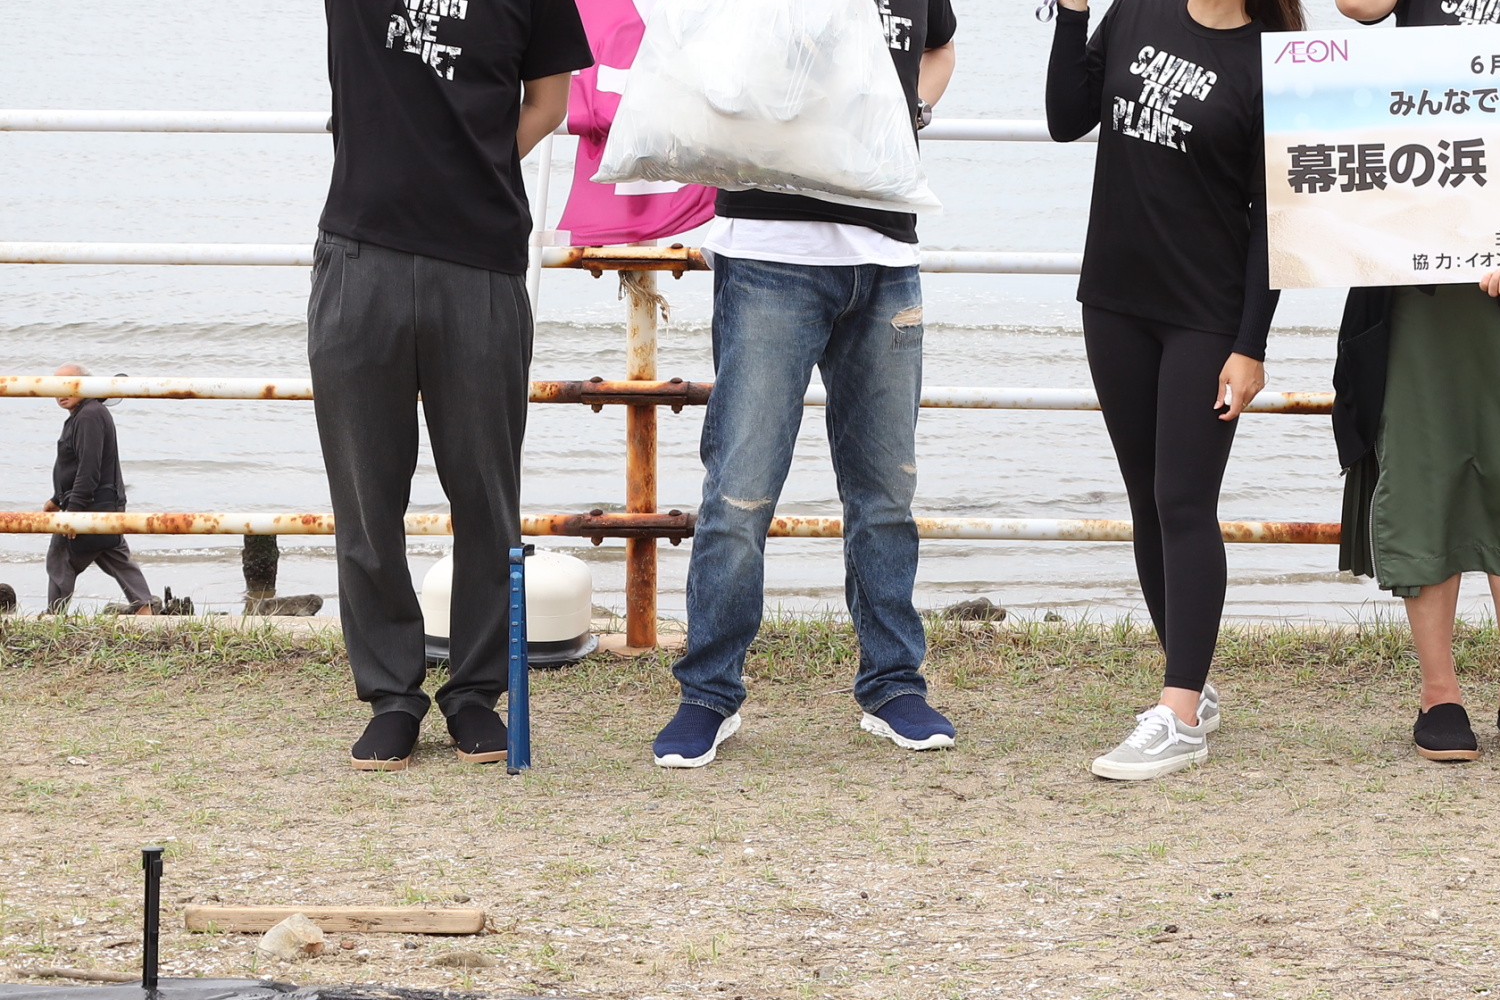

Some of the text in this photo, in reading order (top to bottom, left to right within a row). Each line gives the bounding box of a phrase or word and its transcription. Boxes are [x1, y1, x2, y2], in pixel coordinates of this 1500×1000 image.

[1129, 45, 1218, 102] SAVING
[1138, 79, 1183, 115] THE
[1113, 96, 1193, 153] PLANET
[1287, 138, 1487, 193] 幕張の浜
